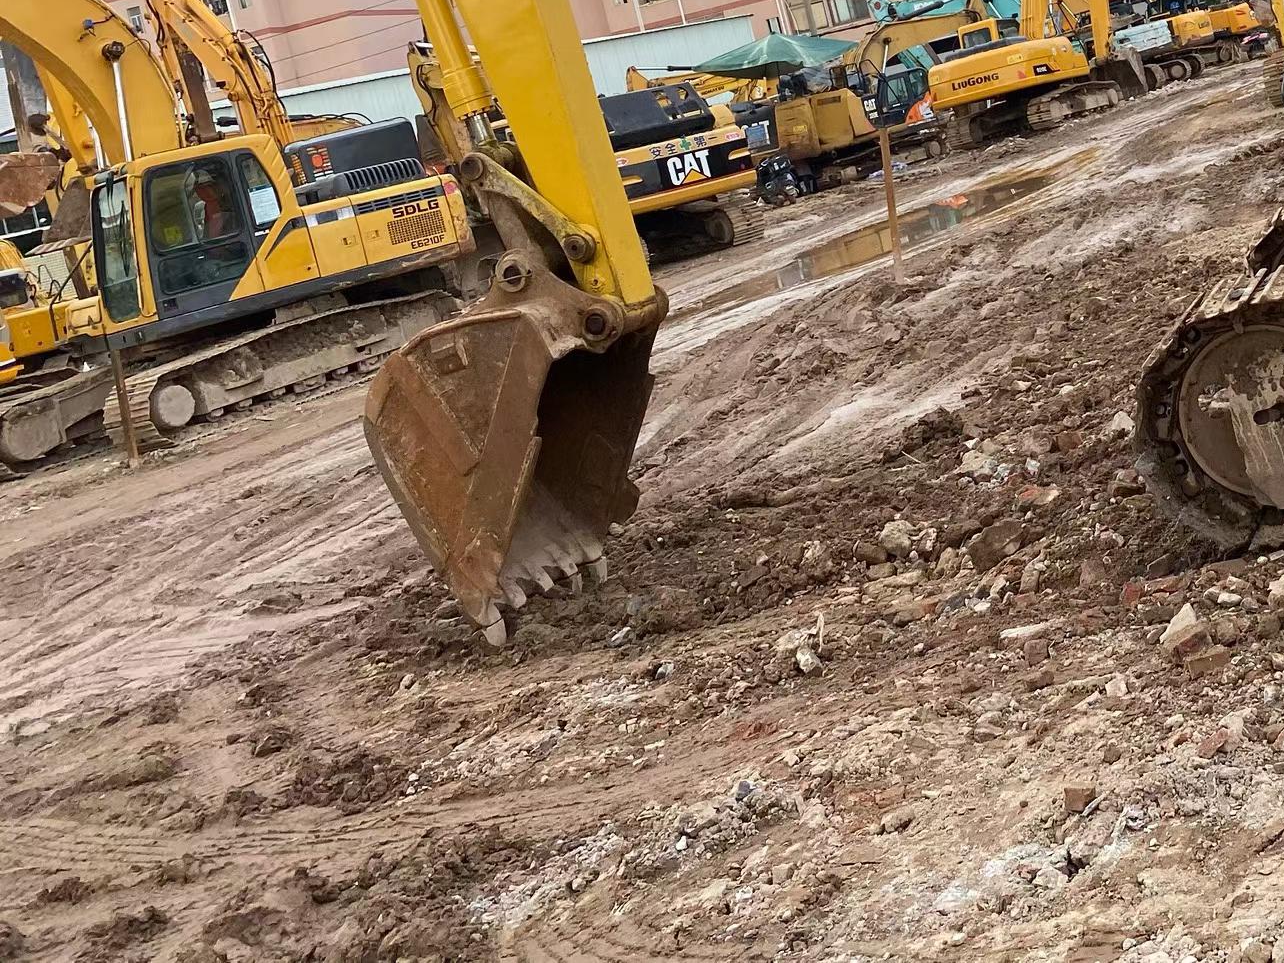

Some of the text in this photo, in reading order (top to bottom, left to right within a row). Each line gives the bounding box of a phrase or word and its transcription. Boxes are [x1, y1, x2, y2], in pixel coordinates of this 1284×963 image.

[649, 142, 678, 158] 安全
[694, 135, 718, 147] 第一
[666, 149, 711, 186] CAT
[391, 199, 440, 219] SDLG
